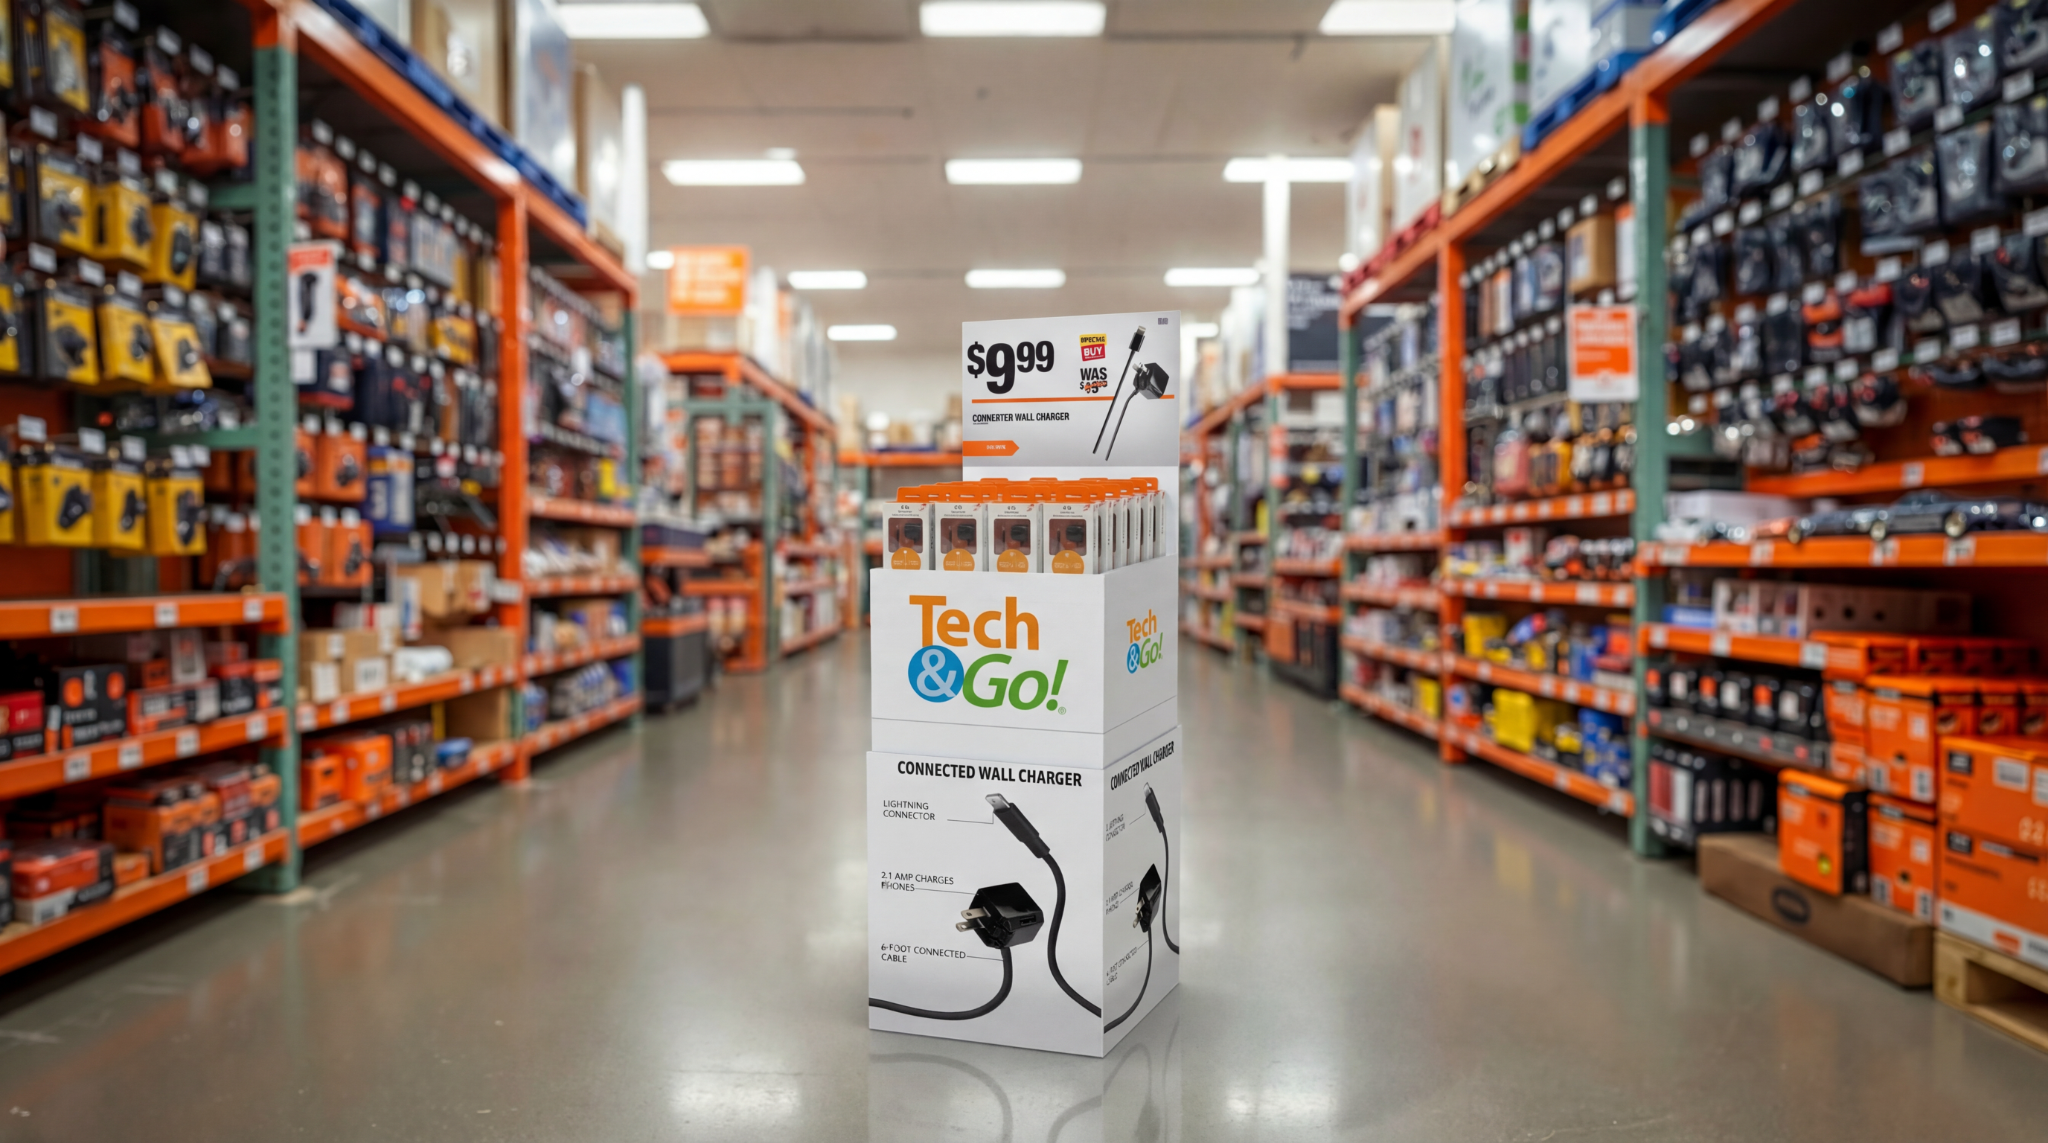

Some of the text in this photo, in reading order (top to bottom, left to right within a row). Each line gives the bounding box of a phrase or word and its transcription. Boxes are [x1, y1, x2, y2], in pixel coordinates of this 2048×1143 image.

[1084, 346, 1102, 356] BUY
[1080, 367, 1107, 381] WAS
[1015, 413, 1035, 422] WALL
[1036, 412, 1070, 422] CHARGER
[909, 595, 1039, 651] Tech
[1126, 609, 1157, 645] Tech
[897, 760, 1083, 787] CONNECTED WALL CHARGER
[883, 799, 929, 810] LIGHTNING
[883, 809, 936, 821] CONNECTOR
[881, 871, 954, 885] 2.1 AMP CHARGES
[881, 953, 908, 964] CABLE
[914, 946, 966, 959] CONNECTED
